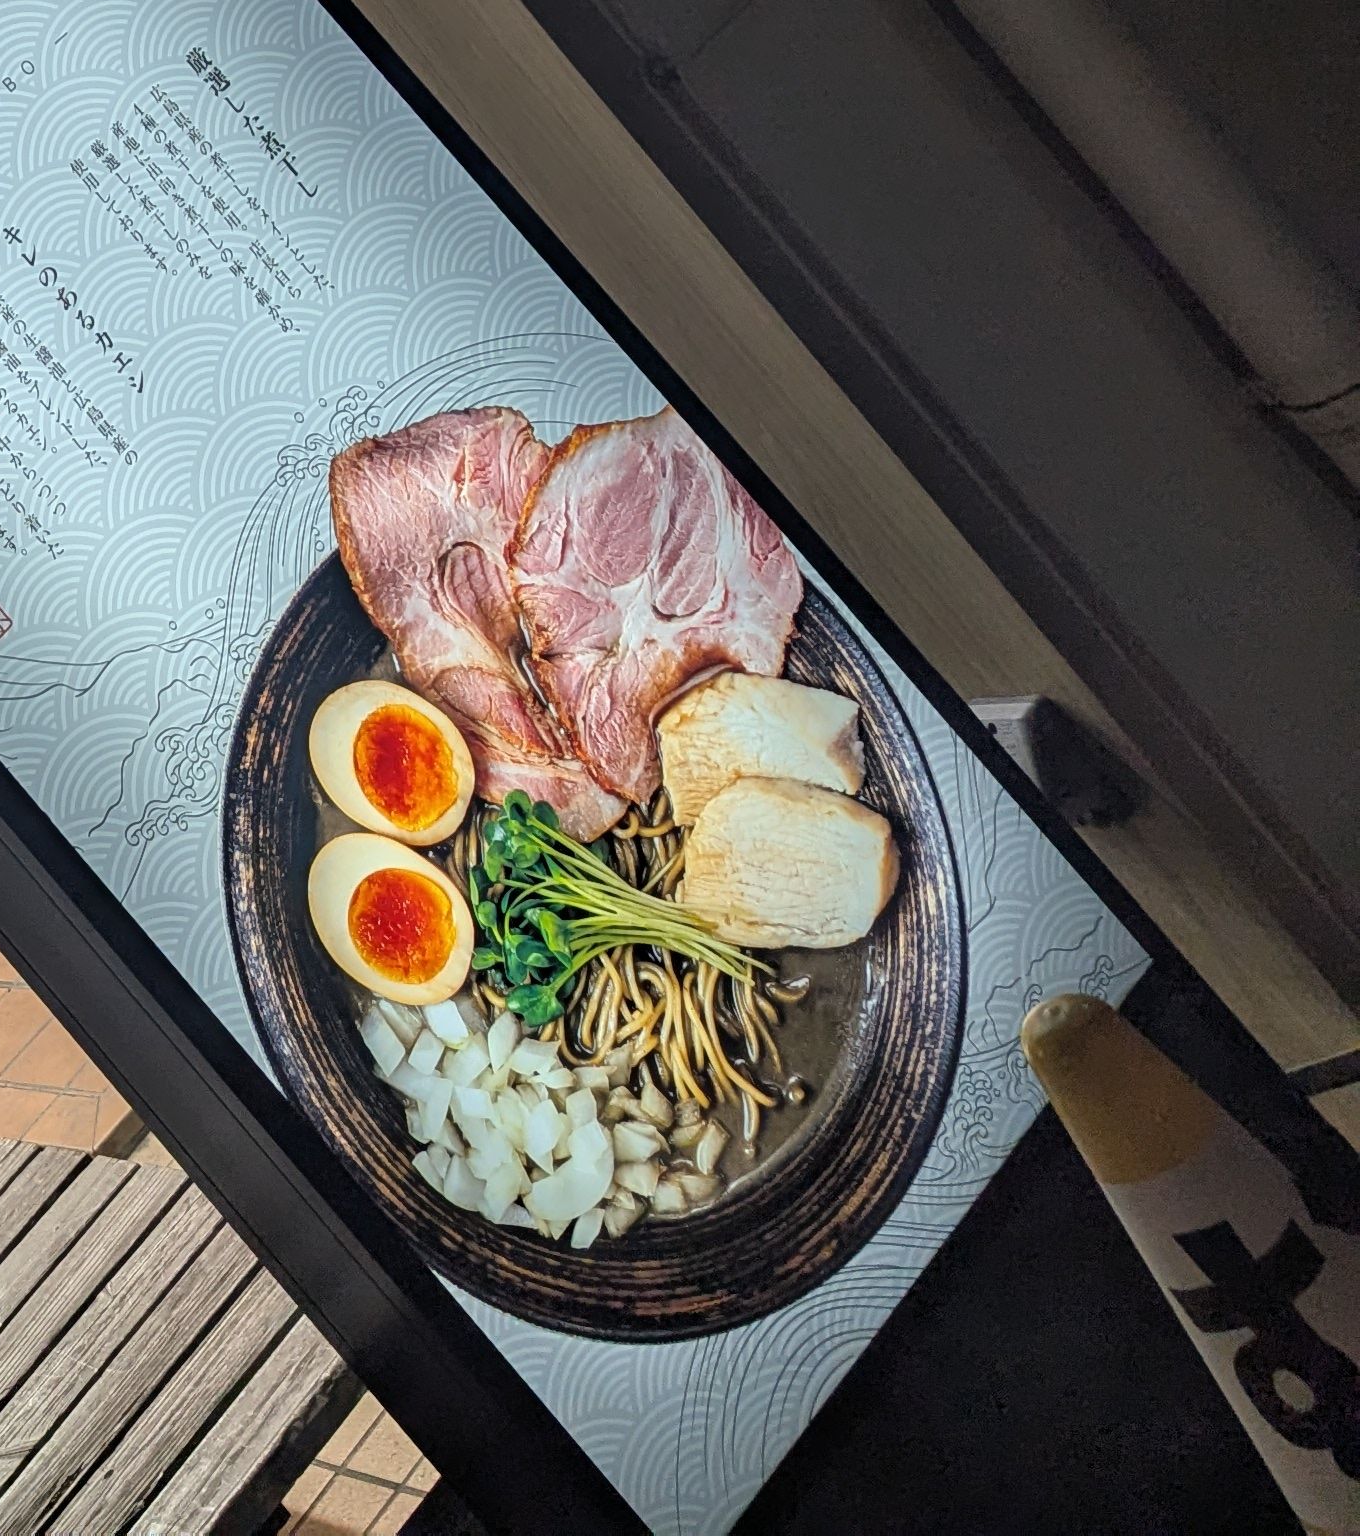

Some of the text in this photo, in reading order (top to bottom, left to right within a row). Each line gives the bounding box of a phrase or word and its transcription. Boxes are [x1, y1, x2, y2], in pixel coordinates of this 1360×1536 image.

[149, 84, 336, 292] 広島県産の煮干しをメインとした、
[185, 46, 319, 199] 厳選した煮干し
[70, 160, 178, 278] 使用しております。
[90, 140, 212, 280] 厳選した煮干しのみを
[110, 121, 302, 335] 産地に出向き煮干しの味を確かめ、
[249, 241, 302, 299] 店長自ら
[3, 225, 144, 395] キレのあるカエシ
